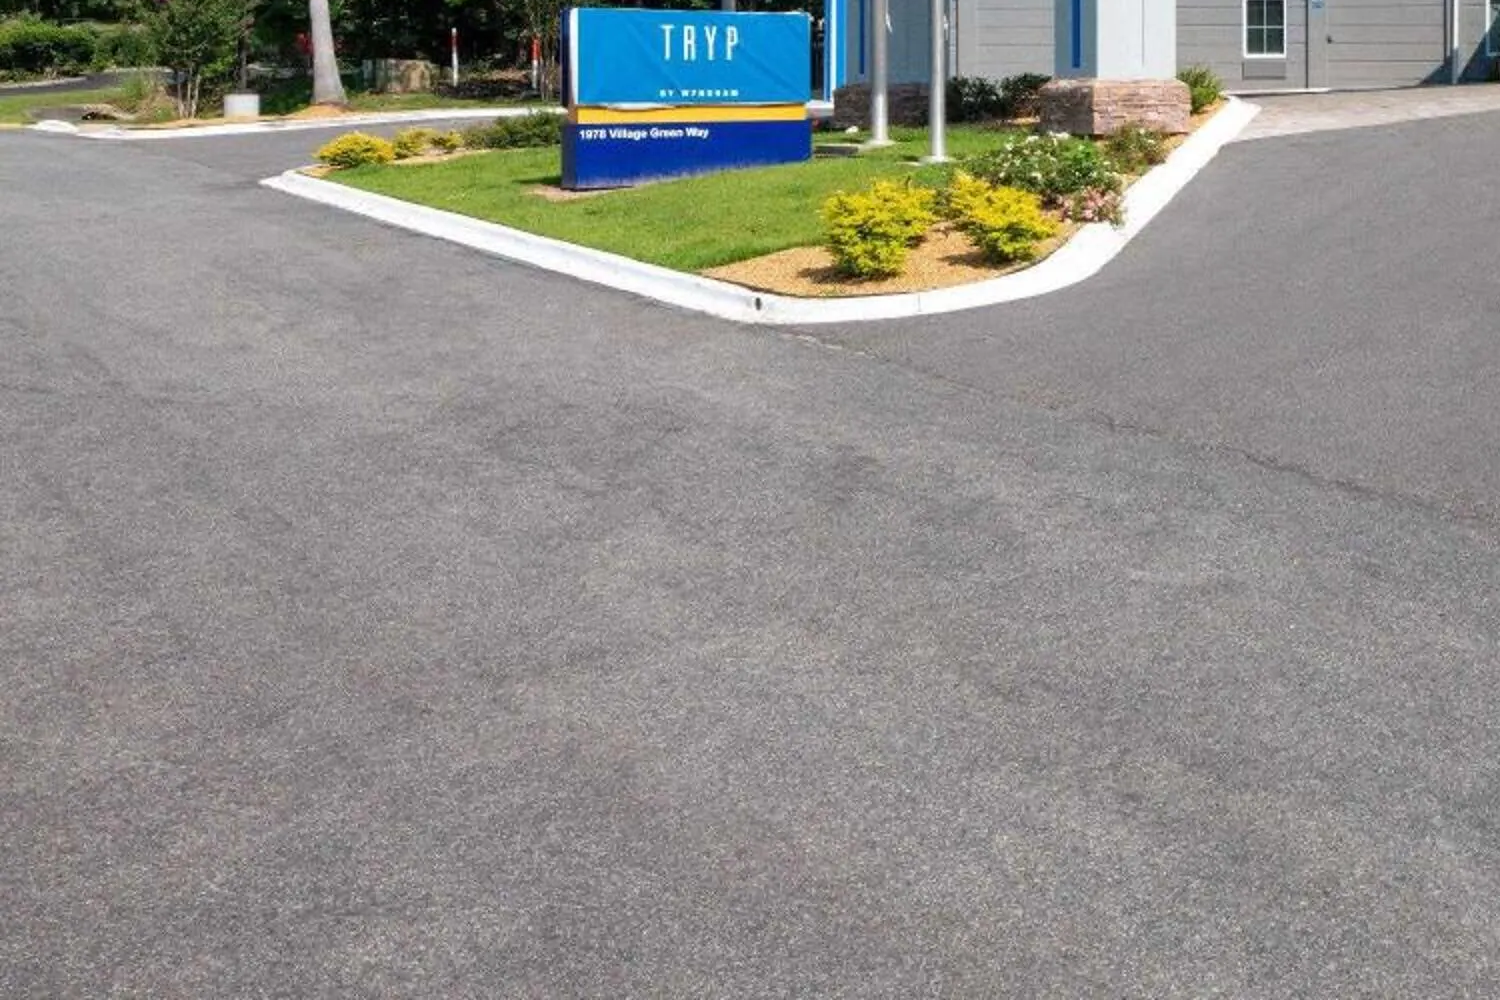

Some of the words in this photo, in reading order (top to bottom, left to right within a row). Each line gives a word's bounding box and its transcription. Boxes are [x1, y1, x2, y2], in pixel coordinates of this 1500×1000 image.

[658, 23, 739, 61] TRYP
[659, 88, 674, 98] BY
[609, 128, 648, 141] Village
[649, 127, 685, 138] Green
[685, 126, 709, 139] Way
